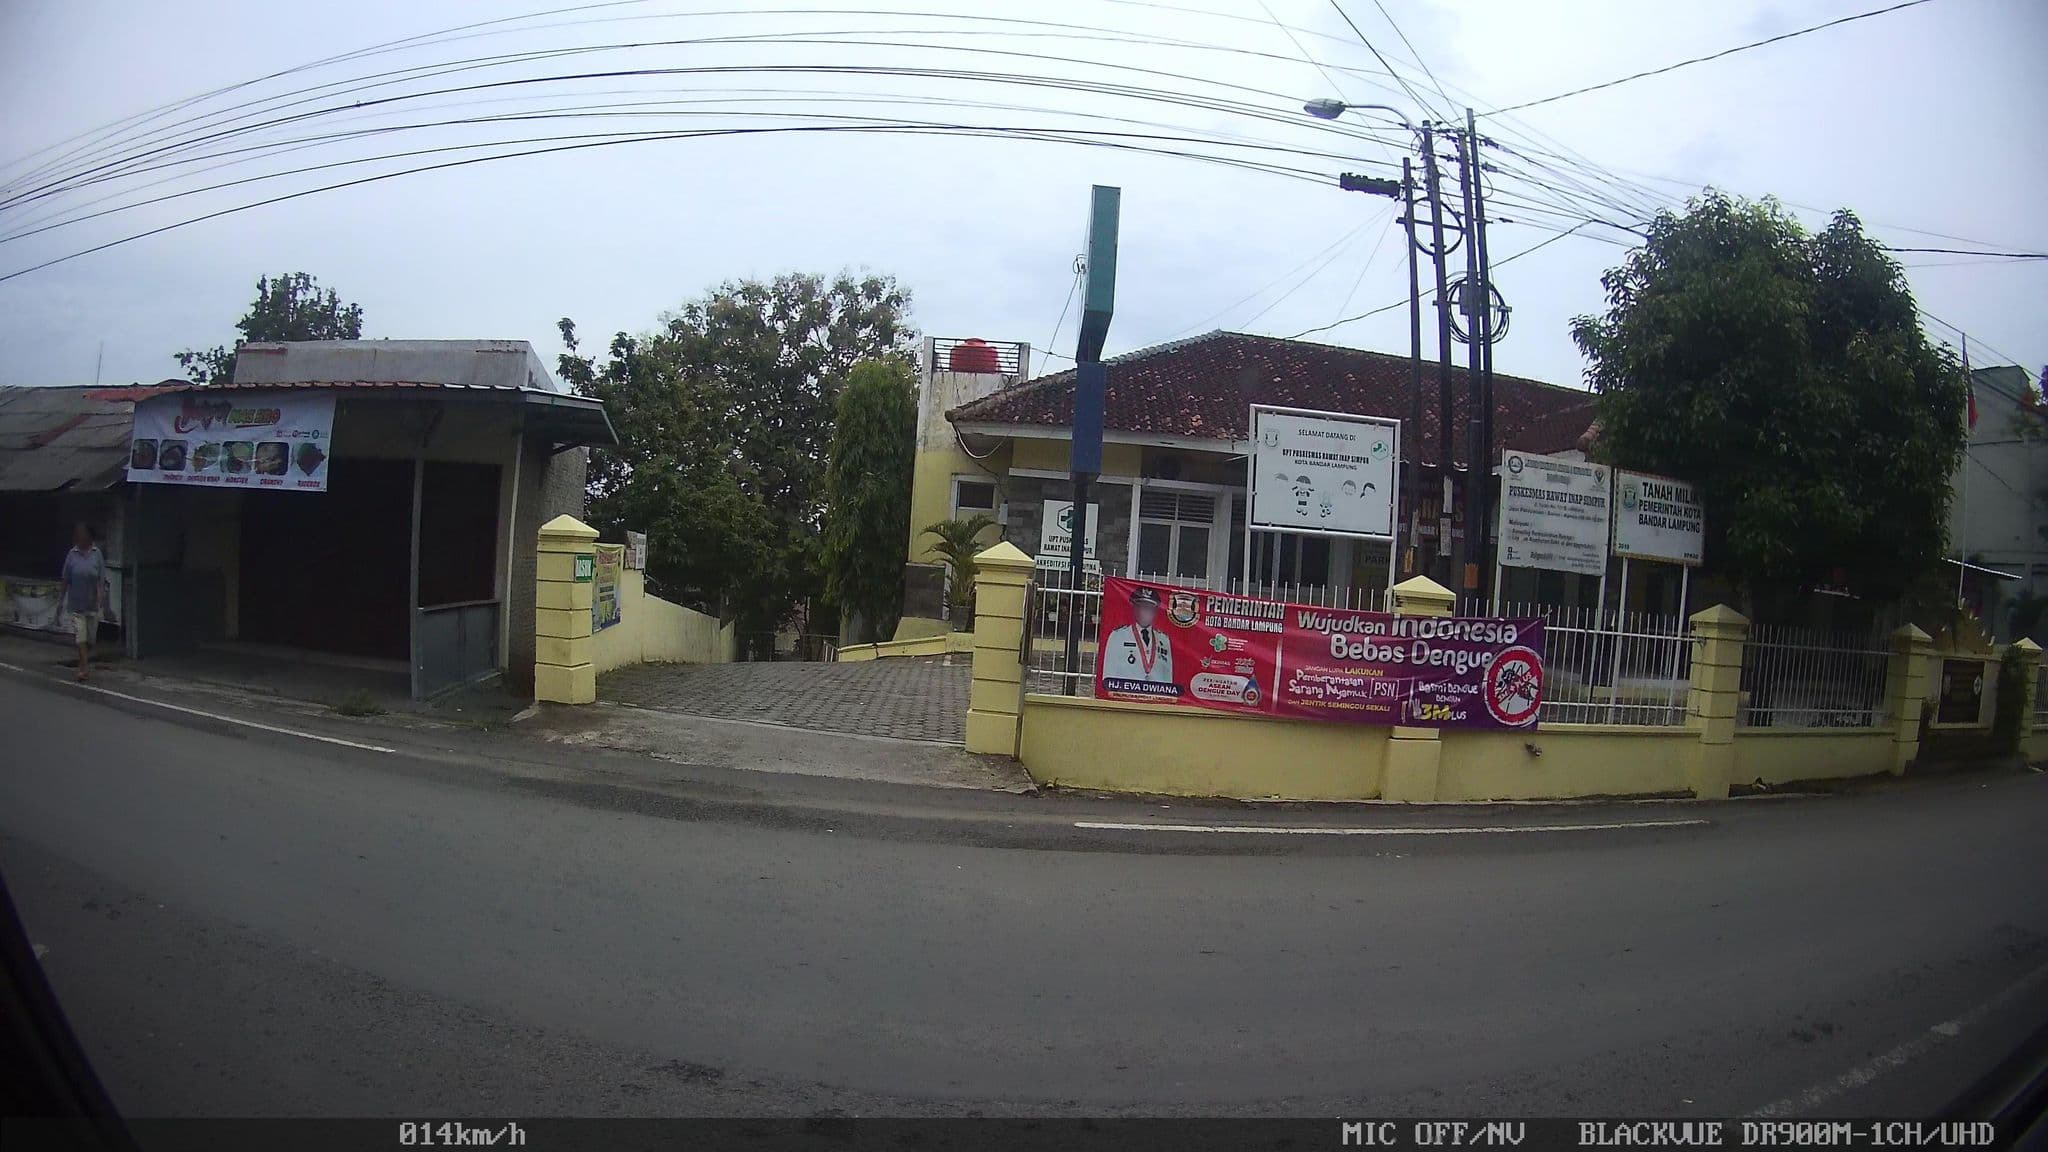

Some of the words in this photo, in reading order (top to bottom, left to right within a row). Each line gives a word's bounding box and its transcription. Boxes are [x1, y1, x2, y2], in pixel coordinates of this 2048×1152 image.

[1298, 429, 1325, 439] SELAMAT
[1325, 432, 1349, 441] DATANG
[1292, 449, 1321, 460] PUSKESMAS
[1321, 452, 1339, 461] RAWAT
[1331, 462, 1358, 471] LAMPUNG
[1508, 485, 1546, 499] PUSKESMAS
[1546, 490, 1568, 503] RAWAT
[1568, 493, 1583, 505] INAP
[1642, 481, 1673, 502] TANAH
[1638, 499, 1682, 516] PEMERINTAH
[1684, 507, 1701, 520] KOTA
[1638, 513, 1667, 529] BANDAR
[1668, 519, 1701, 534] LAMPUNG
[1206, 595, 1286, 620] PEMERINTAH
[1205, 615, 1222, 627] KOTA
[1223, 617, 1250, 630] BANDAR
[1251, 620, 1283, 633] LAMPUNG
[1298, 611, 1386, 635] Wujudkan
[1391, 616, 1518, 645] Indonesia
[1330, 633, 1405, 663] Bebas
[1411, 640, 1493, 675] Dengue
[1296, 669, 1364, 687] Pemberantasan
[1304, 665, 1328, 673] JANGAN
[1344, 667, 1384, 677] LAKUKAN
[1108, 680, 1122, 689] HJ.
[1123, 682, 1141, 691] EVA
[1142, 684, 1178, 694] DWIANA
[1198, 686, 1226, 695] DENGUE
[1226, 689, 1241, 697] DAY
[1289, 679, 1324, 699] Sarang
[1326, 683, 1369, 700] Nyamuk
[1447, 682, 1479, 694] DENGUE
[1301, 699, 1327, 708] JENTIK
[1327, 702, 1365, 710] SEMINGGU
[1366, 704, 1391, 712] SEKALI
